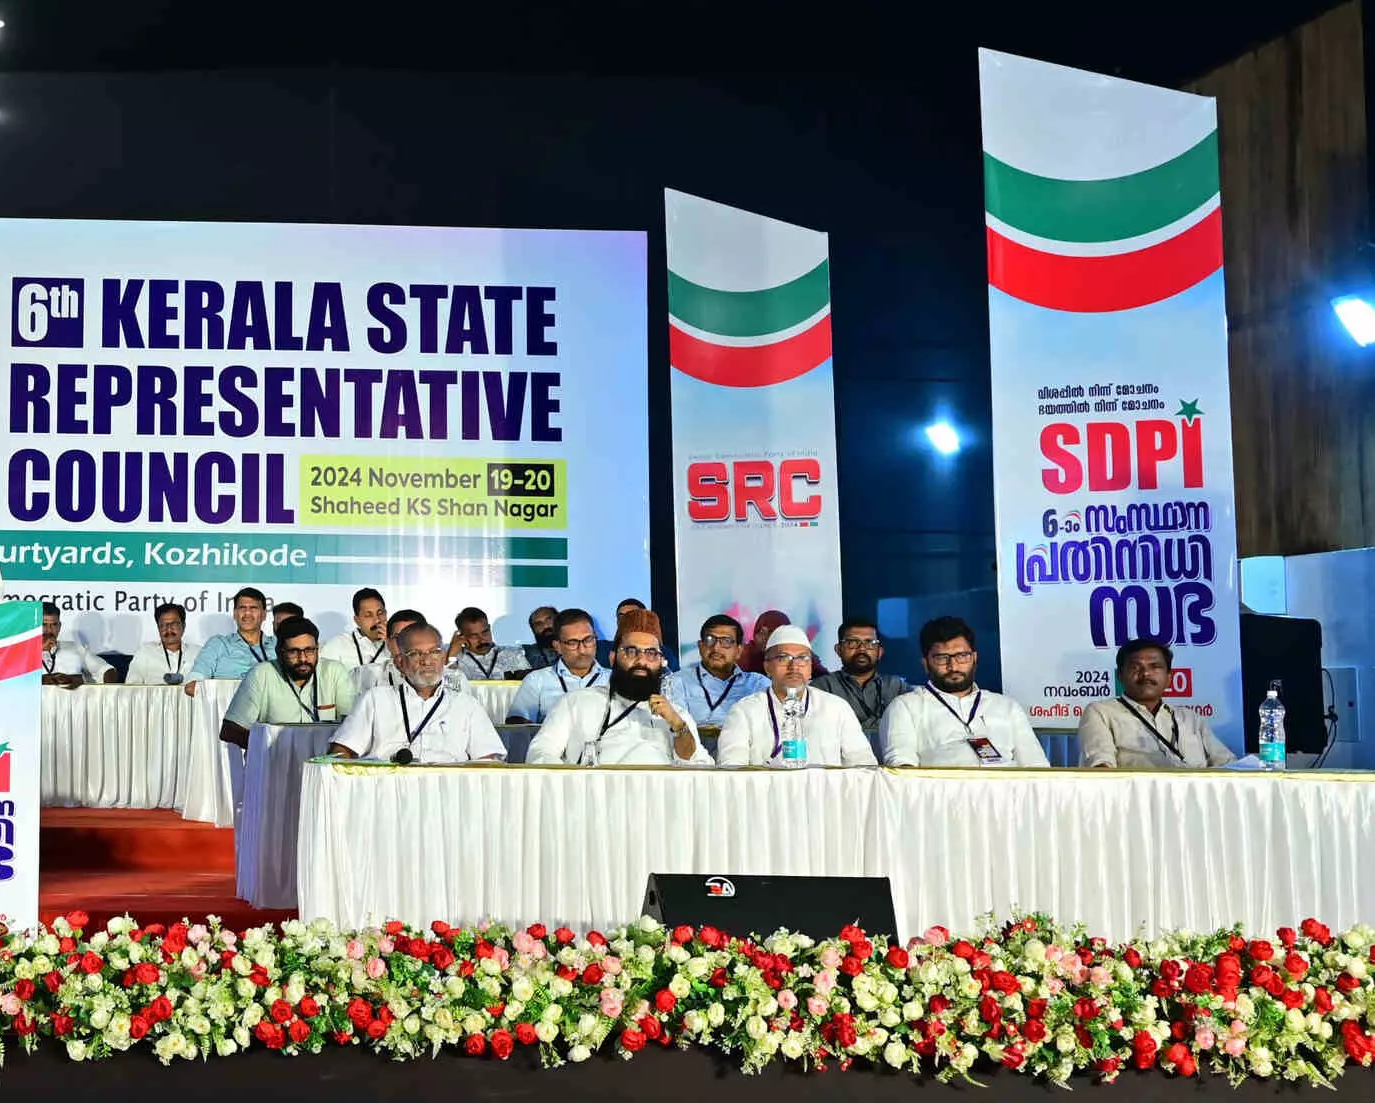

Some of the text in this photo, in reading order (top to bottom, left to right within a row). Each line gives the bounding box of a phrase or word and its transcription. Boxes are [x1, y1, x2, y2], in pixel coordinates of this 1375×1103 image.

[19, 278, 558, 357] 6th KERALA STATE
[8, 363, 562, 442] REPRESENTATIVE
[1040, 416, 1204, 495] SDPI
[7, 448, 295, 525] COUNCIL
[310, 466, 362, 487] 2024
[369, 468, 482, 489] November
[688, 457, 822, 521] SRC
[310, 496, 558, 522] Shaheed KS Shan Nagar
[145, 542, 307, 567] Kozhikode
[184, 590, 209, 612] of
[1076, 671, 1110, 683] 2024
[1044, 685, 1111, 697] നവംബർ
